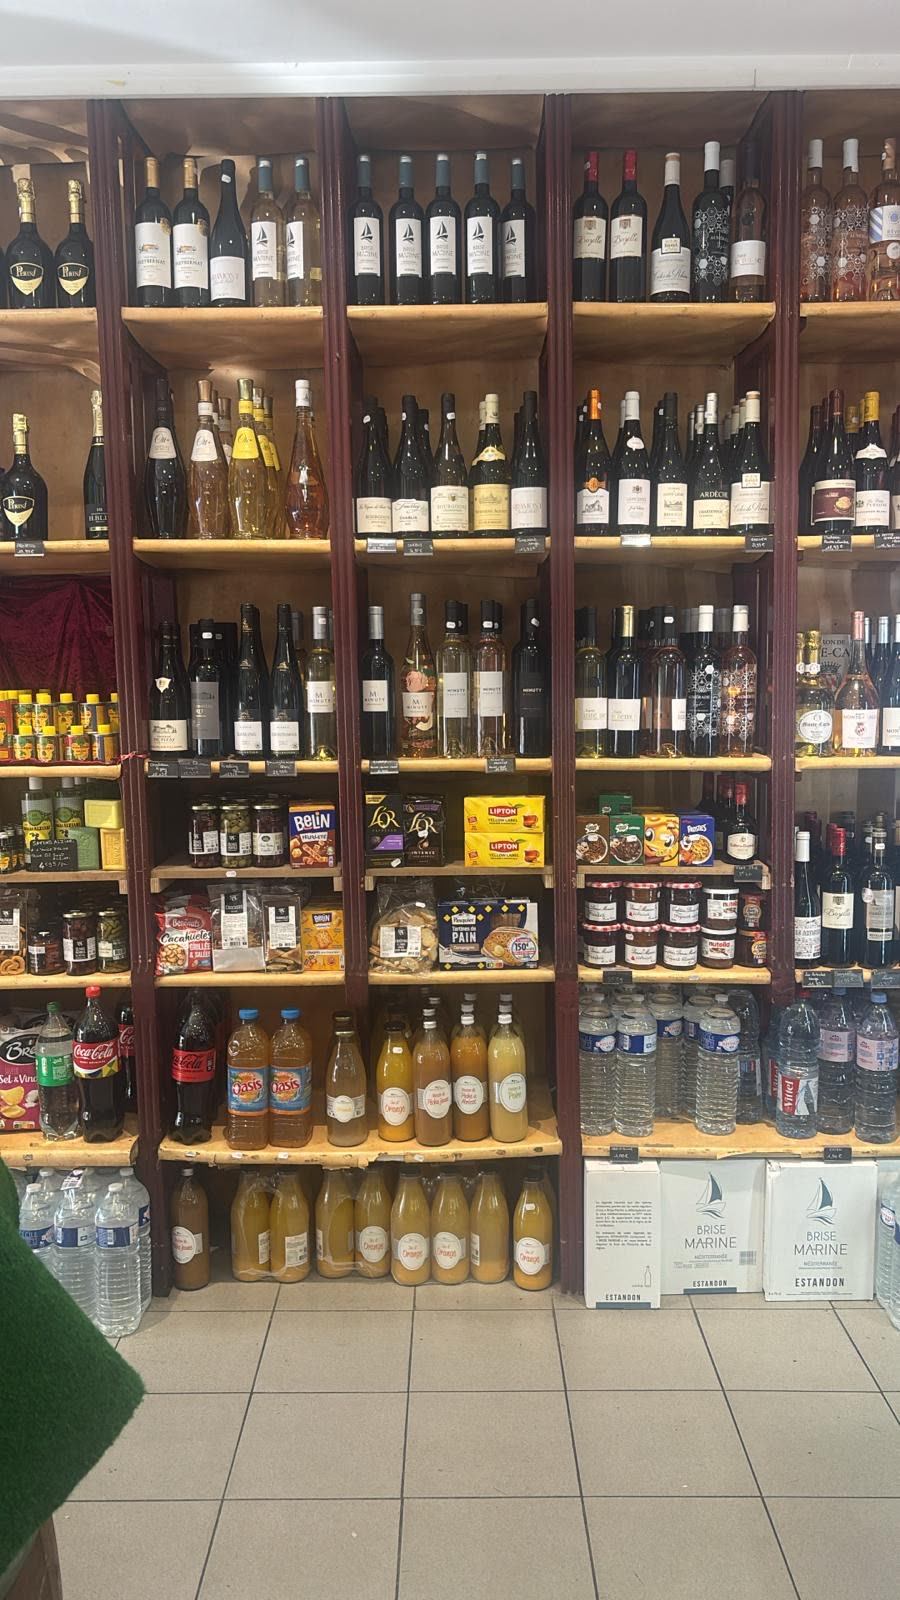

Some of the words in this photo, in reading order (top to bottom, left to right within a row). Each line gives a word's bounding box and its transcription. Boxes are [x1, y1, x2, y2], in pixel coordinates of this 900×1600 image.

[491, 842, 518, 850] LIPTON
[452, 932, 477, 943] PAIN
[73, 1042, 114, 1060] Coca-Cola
[233, 1078, 262, 1095] Oasis
[271, 1078, 300, 1094] Oasis
[783, 1080, 794, 1108] Vittel
[697, 1224, 726, 1235] BRISE
[807, 1231, 837, 1242] BRISE
[684, 1237, 737, 1249] MARINE
[794, 1243, 848, 1256] MARINE
[795, 1278, 845, 1287] ESTANDON
